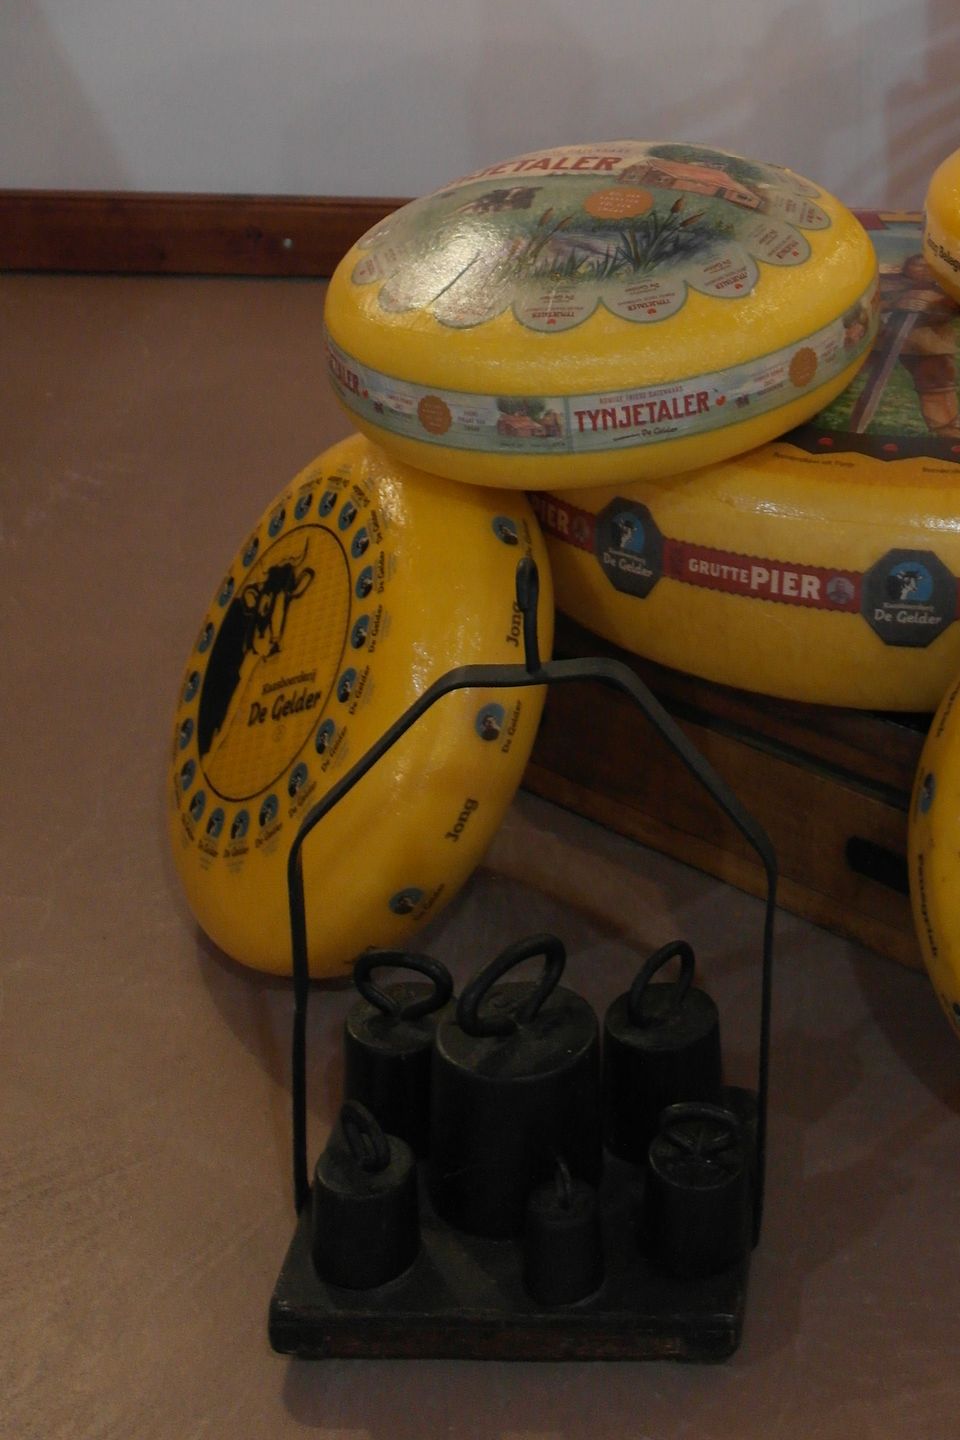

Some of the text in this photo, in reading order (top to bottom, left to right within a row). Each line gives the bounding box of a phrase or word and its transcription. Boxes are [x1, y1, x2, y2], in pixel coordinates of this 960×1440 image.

[574, 390, 710, 433] TYNJETALER
[873, 608, 942, 625] De Gelder
[248, 687, 322, 727] De Gelder
[445, 798, 480, 843] Jong
